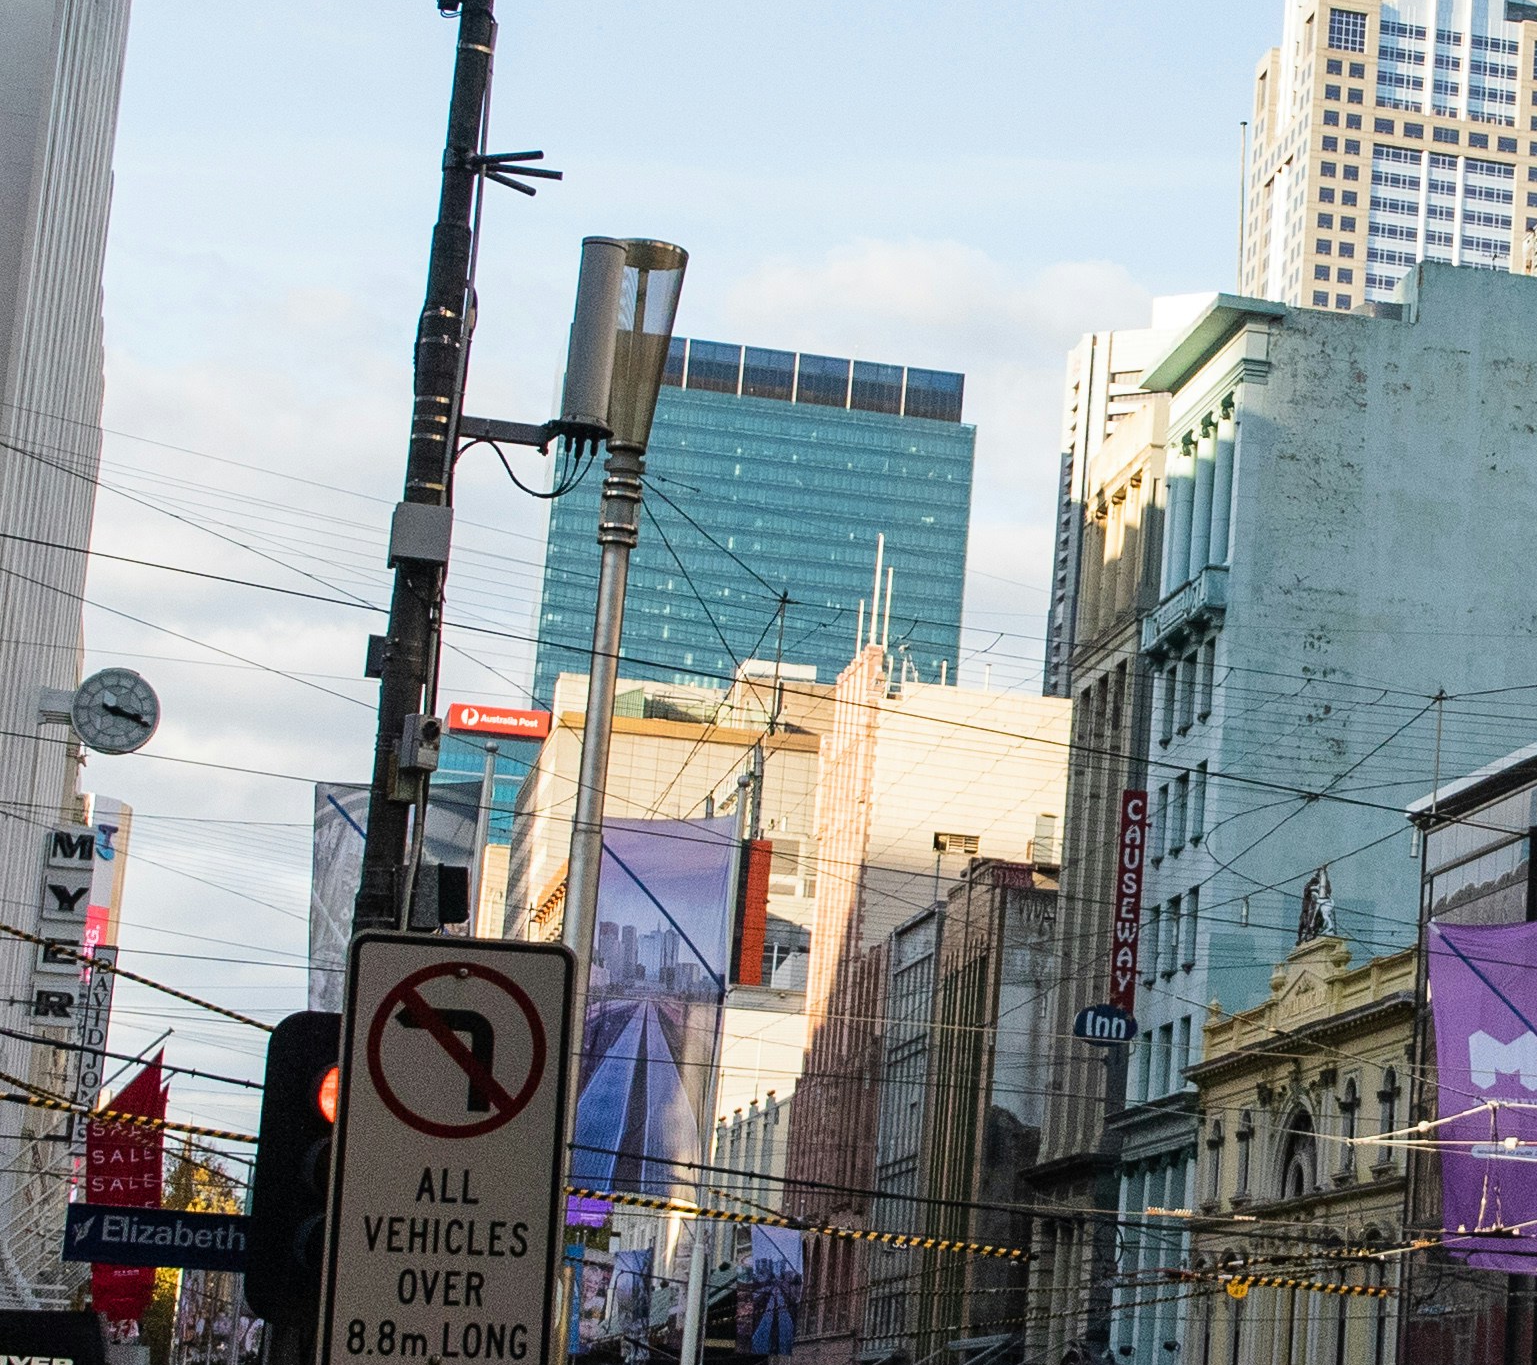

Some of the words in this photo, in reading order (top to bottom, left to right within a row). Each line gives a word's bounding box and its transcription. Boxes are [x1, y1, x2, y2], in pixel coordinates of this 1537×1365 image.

[480, 714, 518, 727] Australia
[519, 718, 539, 728] Post
[1116, 798, 1143, 993] CAUSEWAY
[36, 833, 96, 1019] MYER
[1086, 1010, 1127, 1039] Inn
[92, 1148, 155, 1165] SALE
[92, 1174, 155, 1192] SALE
[415, 1166, 480, 1205] ALL
[101, 1215, 246, 1251] Elizabeth
[364, 1215, 529, 1258] VEHICLES
[397, 1268, 485, 1307] OVER
[346, 1318, 428, 1356] 8.8m
[442, 1321, 528, 1360] LONG
